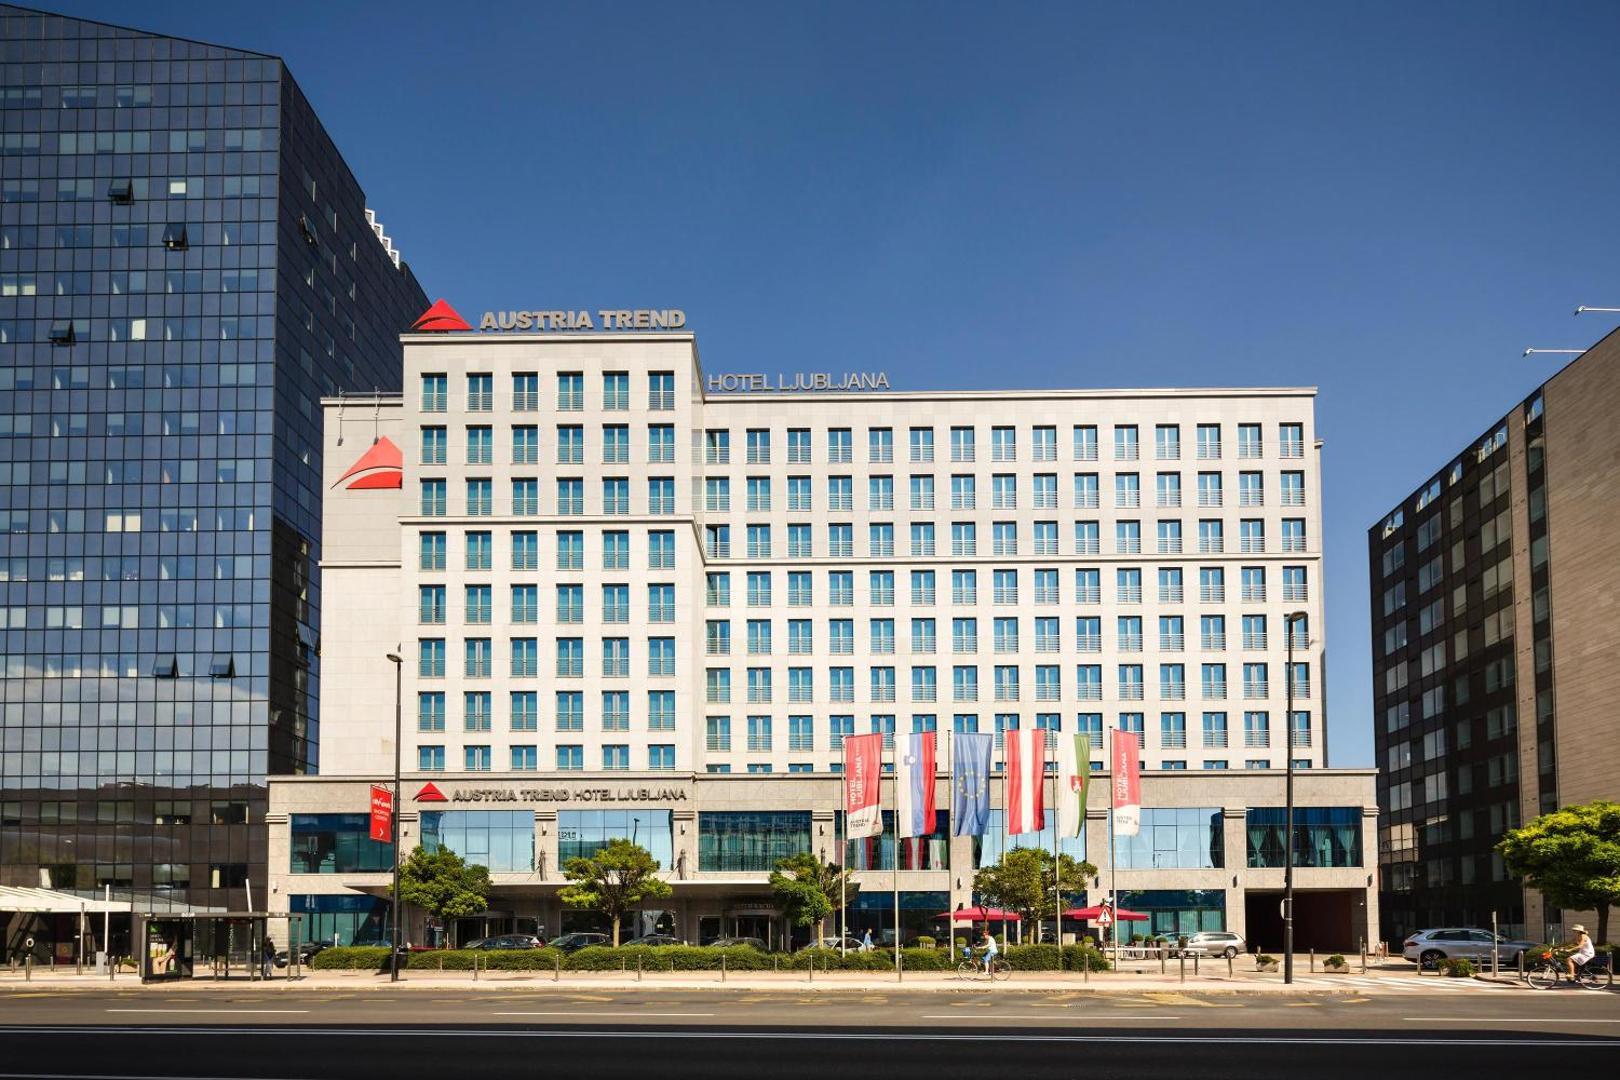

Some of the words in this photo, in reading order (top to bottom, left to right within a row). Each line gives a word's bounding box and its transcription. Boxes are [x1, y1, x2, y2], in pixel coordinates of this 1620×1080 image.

[480, 310, 594, 330] AUSTRIA
[598, 309, 686, 329] TREND
[708, 373, 774, 391] HOTEL
[779, 372, 890, 391] LJUBLJANA
[856, 756, 864, 805] LJUBLJANA
[452, 789, 517, 801] AUSTRIA
[520, 789, 570, 801] TREND
[574, 789, 615, 801] HOTEL
[617, 789, 687, 801] LJUBLJANA
